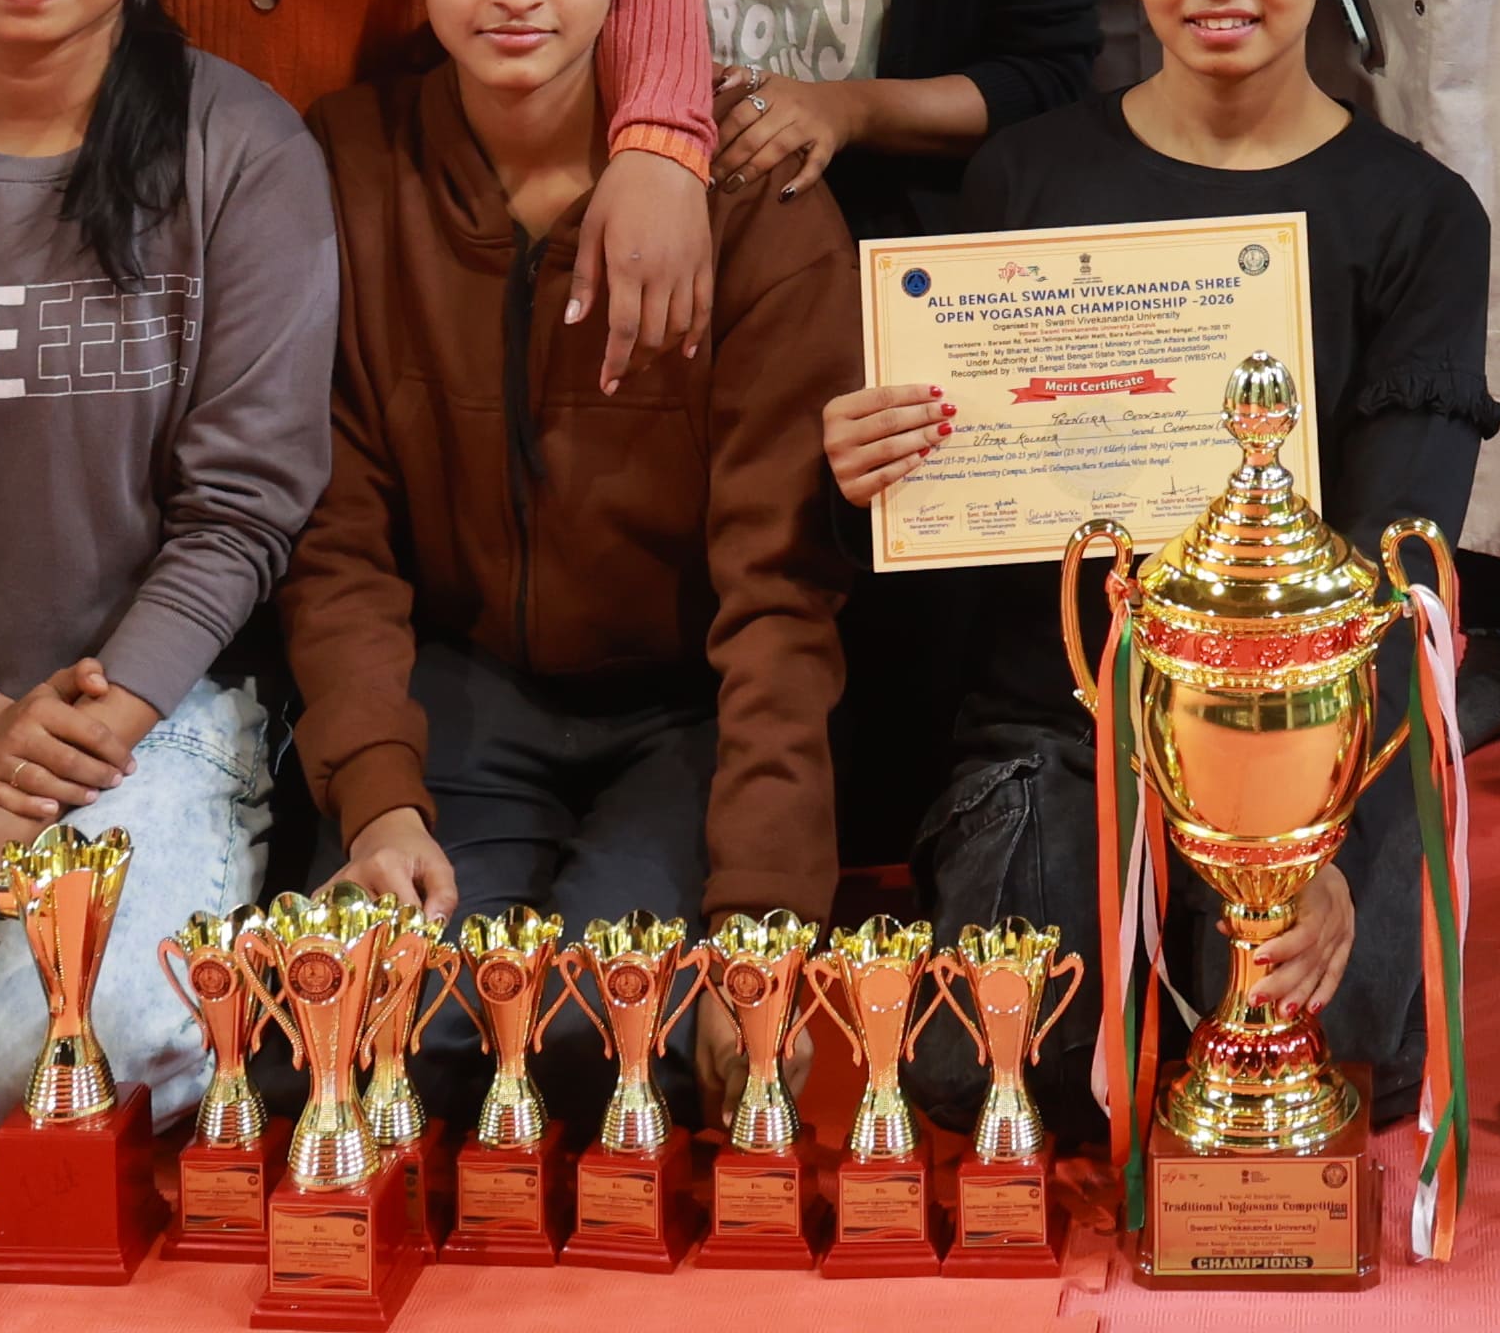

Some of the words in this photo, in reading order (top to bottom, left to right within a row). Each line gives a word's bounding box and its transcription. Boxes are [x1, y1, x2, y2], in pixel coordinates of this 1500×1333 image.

[927, 295, 953, 307] ALL
[958, 291, 1017, 306] BENGAL
[1021, 288, 1075, 301] SWAMI
[1080, 280, 1191, 297] VIVEKANANDA
[1195, 276, 1240, 290] SHREE
[935, 310, 974, 323] OPEN
[979, 304, 1065, 320] YOGASANA
[1071, 297, 1187, 314] CHAMPIONSHIP
[1045, 379, 1078, 393] Merit
[1080, 375, 1145, 392] Certificate
[1162, 1202, 1224, 1212] Traditional
[1228, 1202, 1279, 1214] Yogasana
[1197, 1258, 1308, 1269] CHAMPIONS
